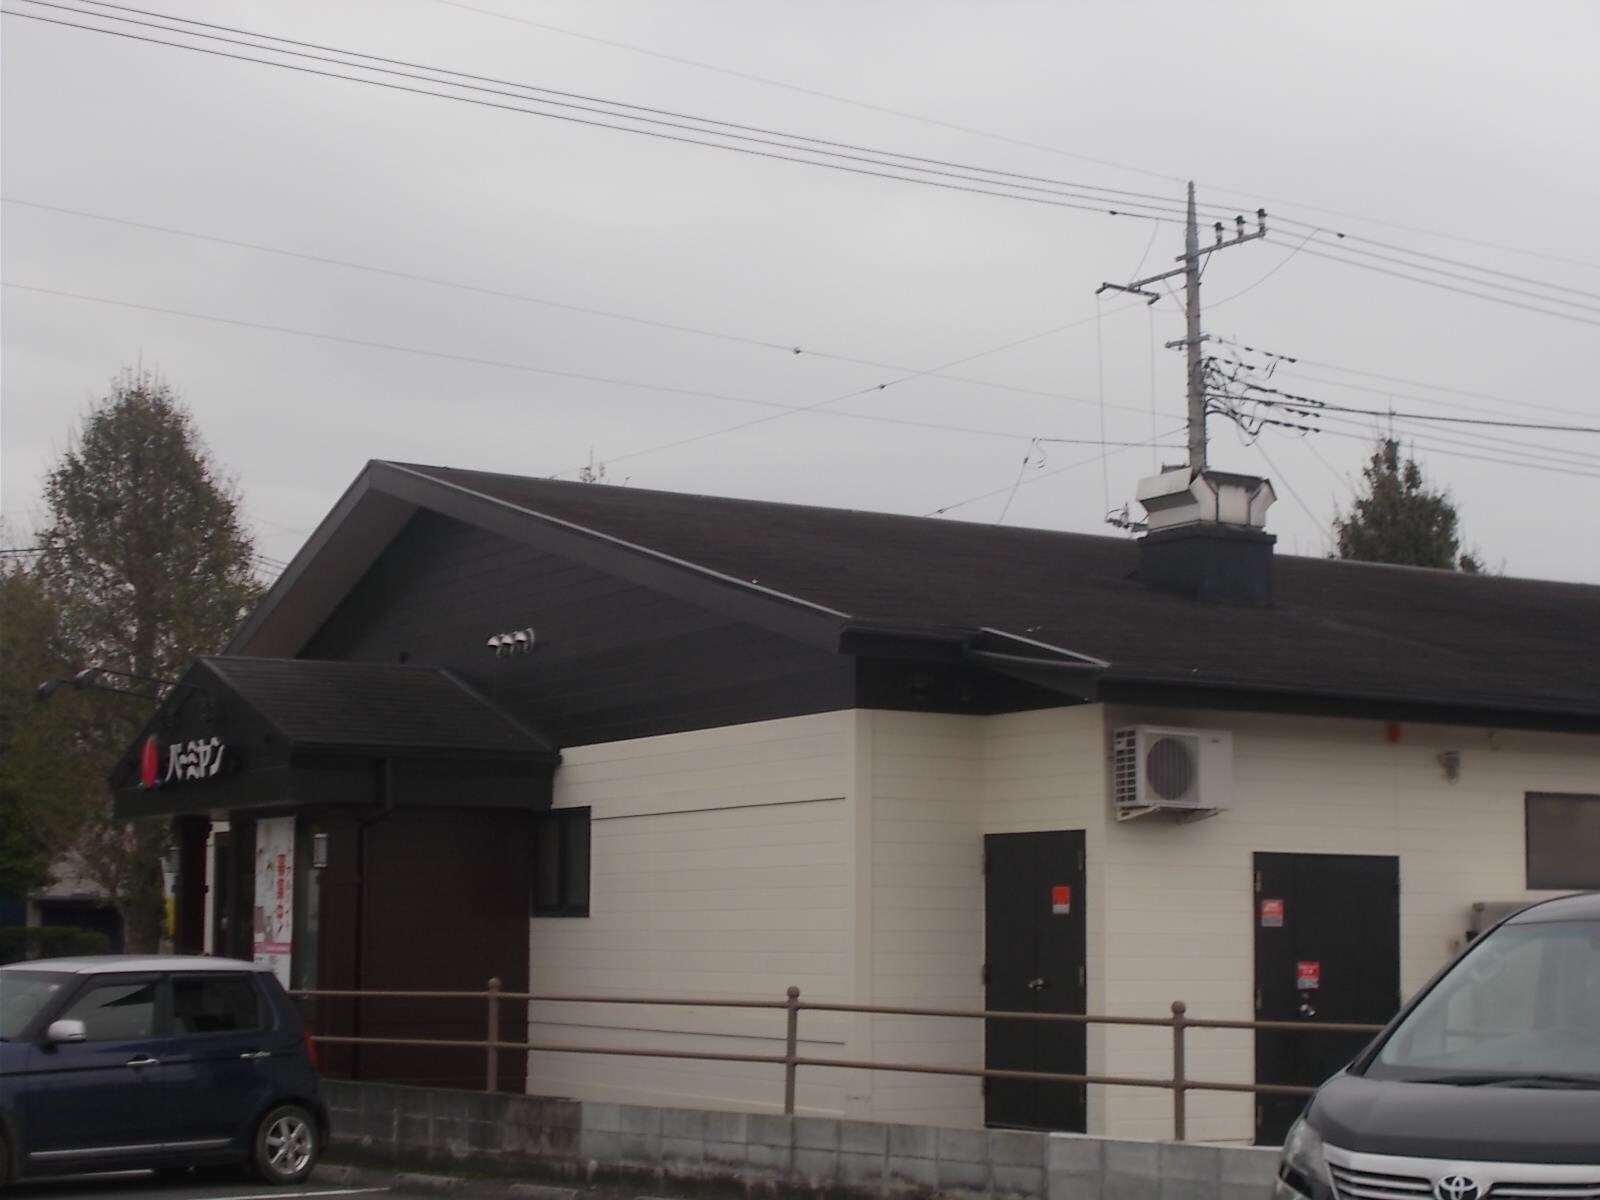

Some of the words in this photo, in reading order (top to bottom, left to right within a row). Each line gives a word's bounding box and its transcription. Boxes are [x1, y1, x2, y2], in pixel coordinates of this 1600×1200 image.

[164, 736, 224, 782] バーミヤン
